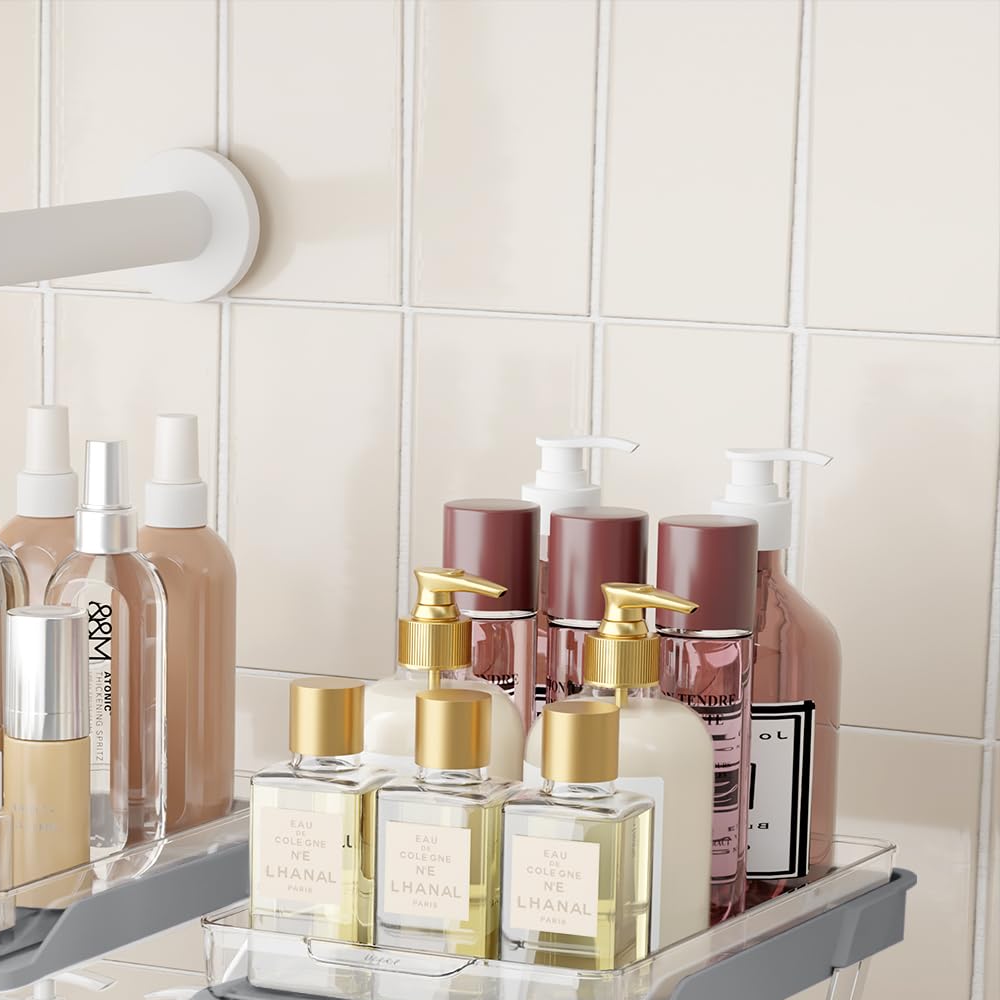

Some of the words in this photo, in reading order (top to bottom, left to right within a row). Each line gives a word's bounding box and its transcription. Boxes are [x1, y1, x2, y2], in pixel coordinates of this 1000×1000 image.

[104, 671, 112, 712] ATONIC
[95, 672, 103, 727] THICKENING
[95, 730, 104, 761] SPRITZ
[290, 820, 313, 830] EAU
[415, 834, 438, 845] EAU
[543, 849, 568, 860] EAU
[265, 865, 337, 884] LHANAL
[288, 885, 313, 894] PARIS
[391, 880, 462, 899] LHANAL
[412, 900, 438, 909] PARIS
[517, 896, 592, 916] LHANAL
[540, 916, 566, 925] PARIS
